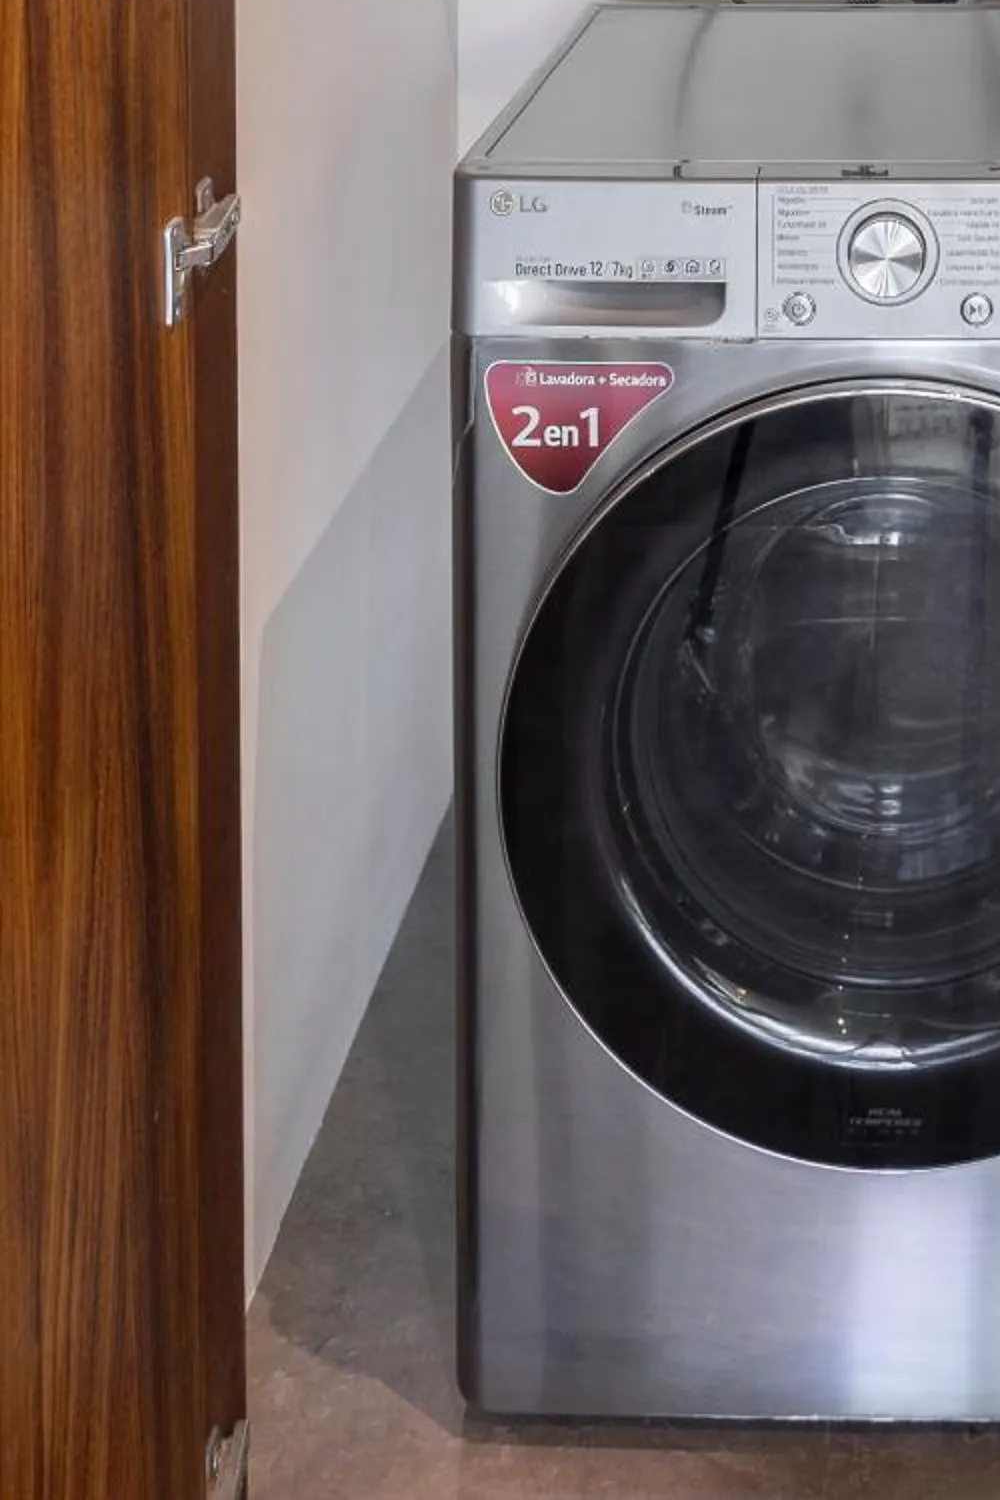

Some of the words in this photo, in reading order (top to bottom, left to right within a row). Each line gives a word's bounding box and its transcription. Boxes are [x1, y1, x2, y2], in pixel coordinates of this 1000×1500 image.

[519, 196, 548, 213] LG
[514, 262, 551, 277] Direct
[554, 261, 587, 277] Drive
[539, 371, 595, 386] Lavadora
[609, 372, 667, 387] Secadora
